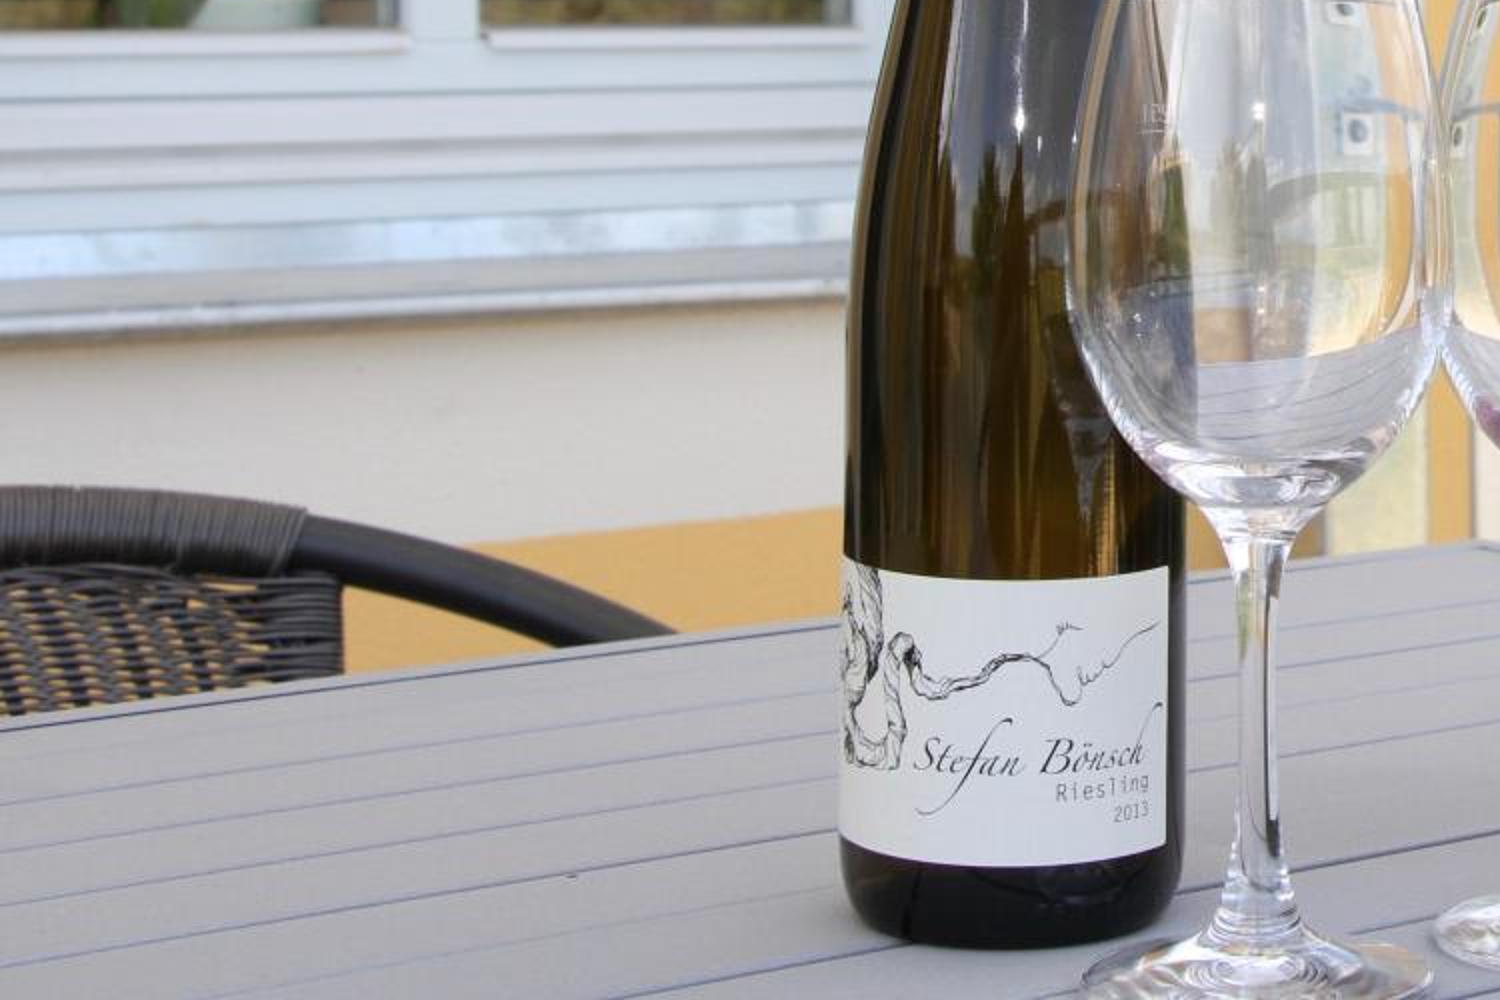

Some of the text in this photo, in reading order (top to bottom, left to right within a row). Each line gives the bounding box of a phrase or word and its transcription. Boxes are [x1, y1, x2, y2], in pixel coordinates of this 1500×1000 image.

[914, 702, 1163, 815] Stefan Bönsch
[1056, 775, 1149, 802] Riesling
[1114, 801, 1149, 822] 2013
